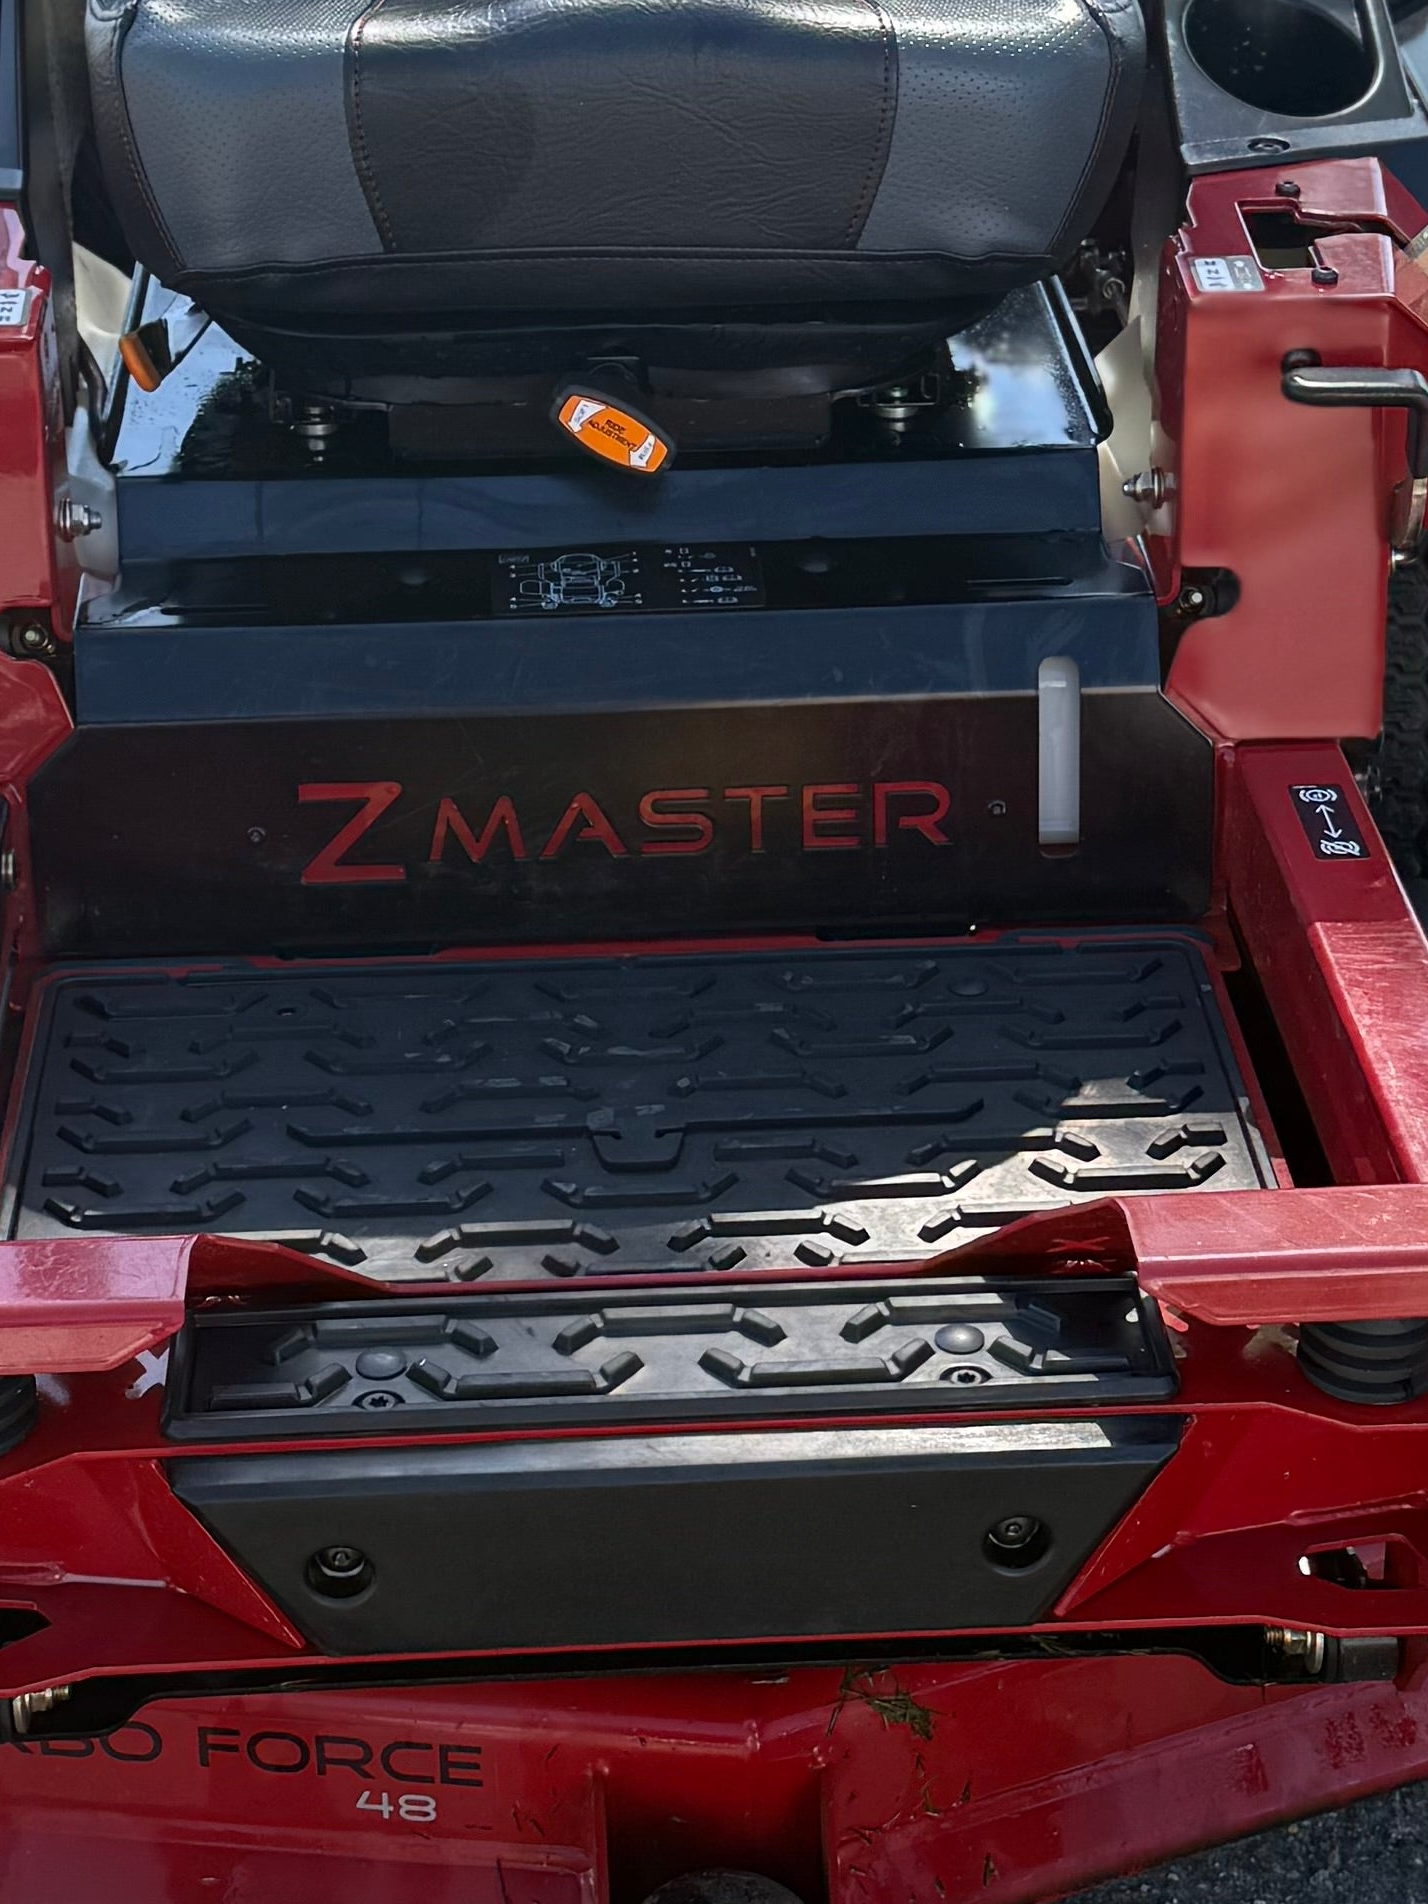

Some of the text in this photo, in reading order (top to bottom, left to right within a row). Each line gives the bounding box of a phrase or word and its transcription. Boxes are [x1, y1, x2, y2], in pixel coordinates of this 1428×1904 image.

[297, 779, 953, 886] Z MASTER
[196, 1725, 484, 1788] FORCE
[355, 1790, 438, 1823] 48
